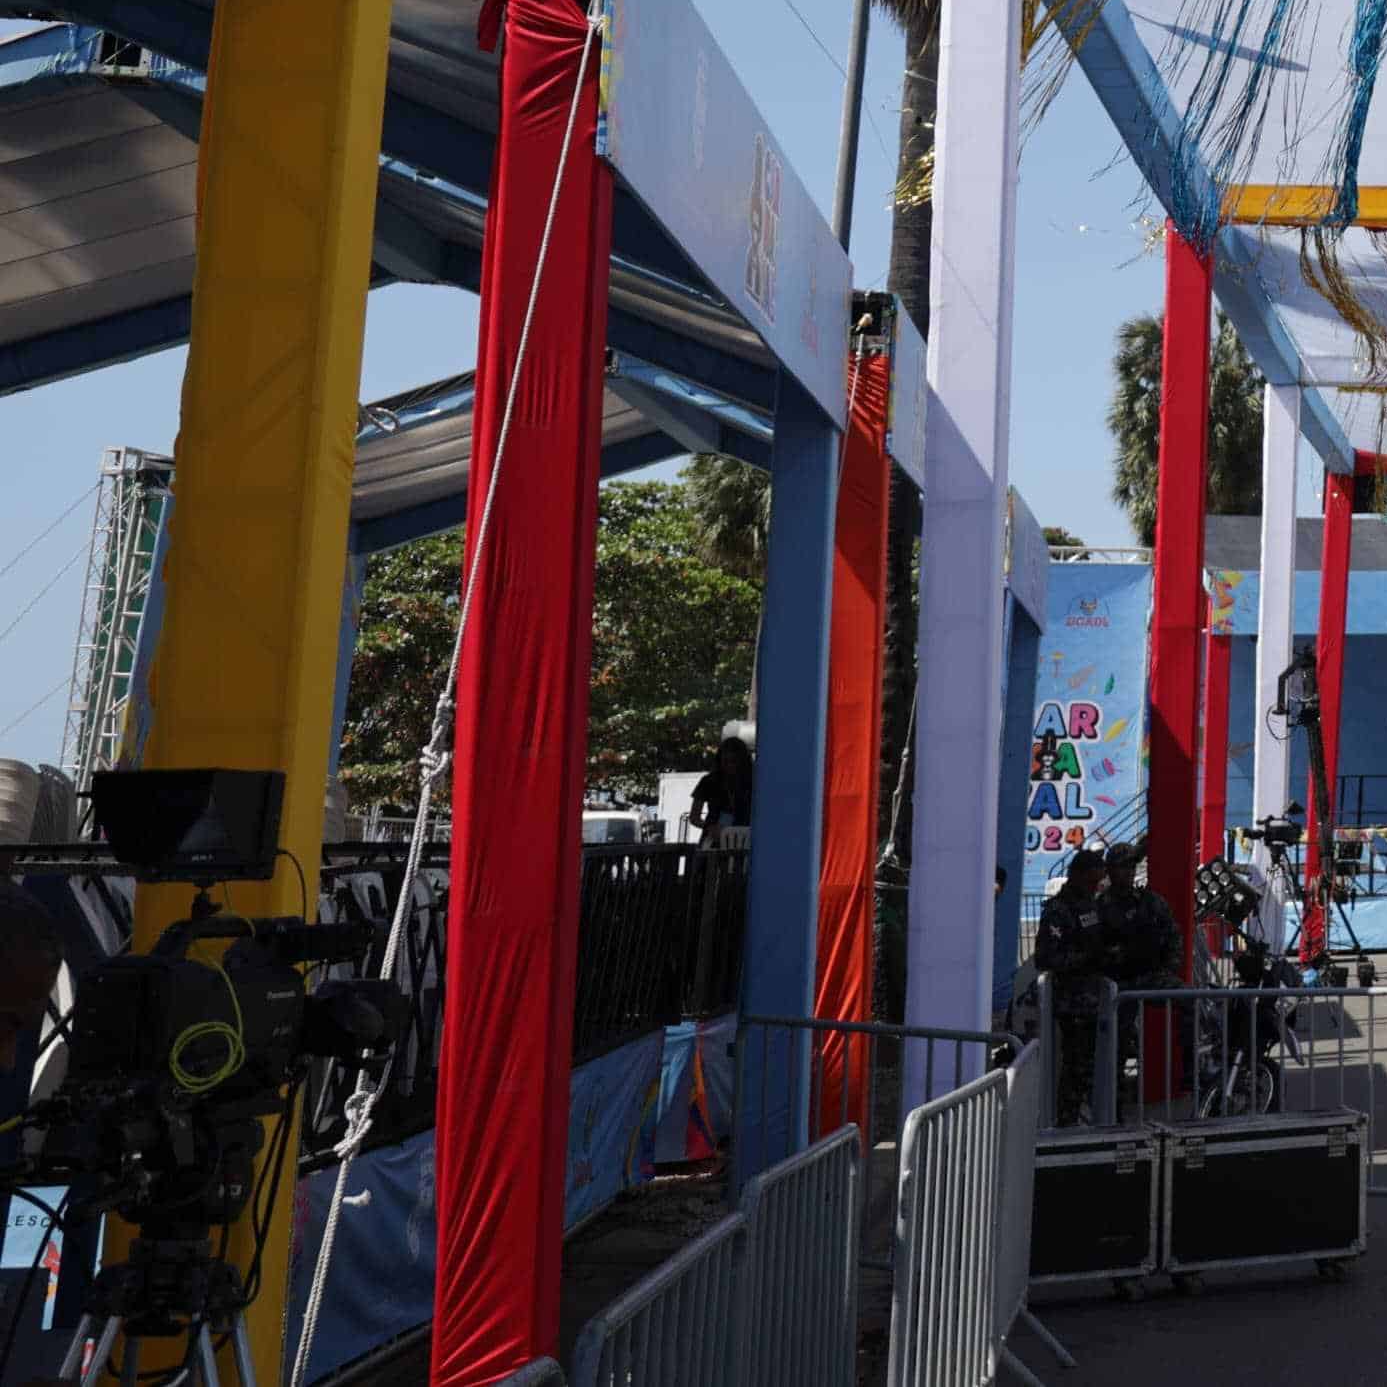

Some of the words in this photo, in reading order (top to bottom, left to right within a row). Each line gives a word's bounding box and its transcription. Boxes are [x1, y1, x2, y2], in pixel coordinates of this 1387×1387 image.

[1033, 702, 1099, 739] AR
[1028, 781, 1092, 820] AL
[1025, 825, 1085, 851] 024
